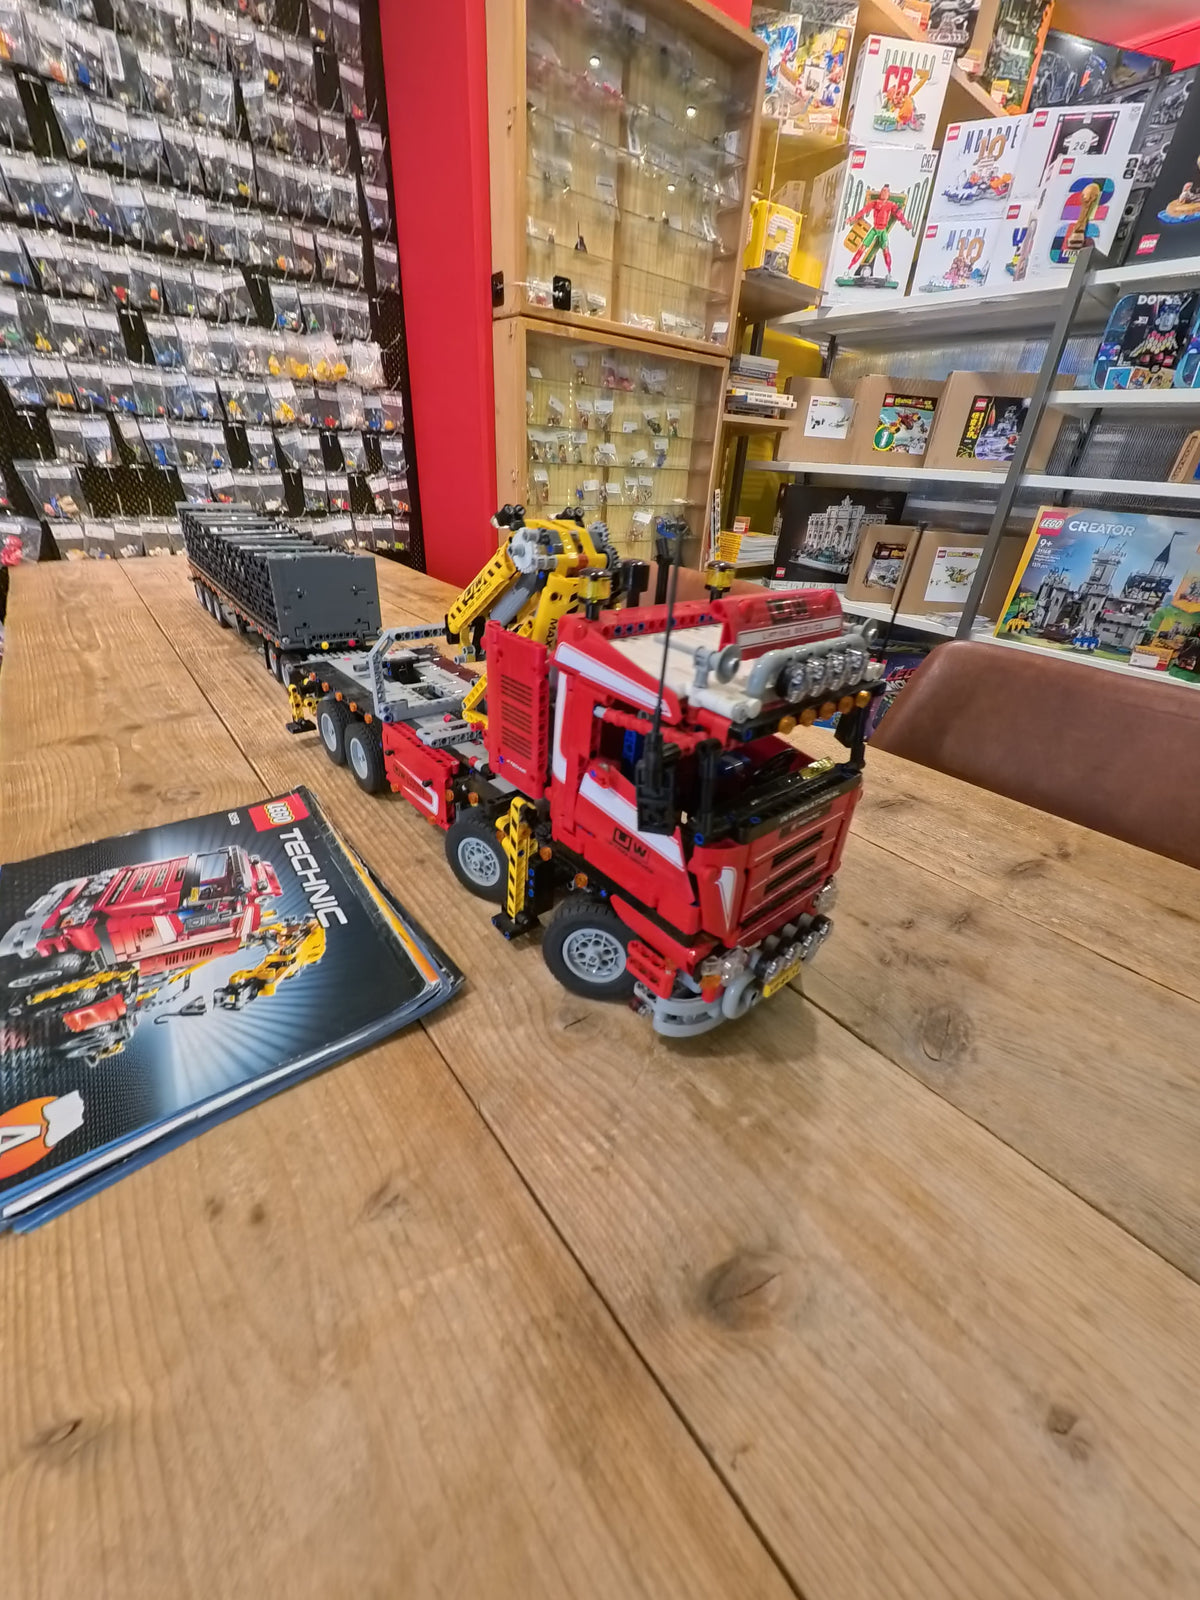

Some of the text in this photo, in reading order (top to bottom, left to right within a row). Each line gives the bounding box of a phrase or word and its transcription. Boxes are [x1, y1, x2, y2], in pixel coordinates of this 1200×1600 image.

[921, 154, 937, 169] CR7
[1040, 518, 1136, 537] LEGO CREATOR
[1040, 538, 1053, 548] 9+
[545, 618, 558, 648] MAX
[264, 801, 295, 825] LEGO
[280, 827, 349, 928] TECHNIC
